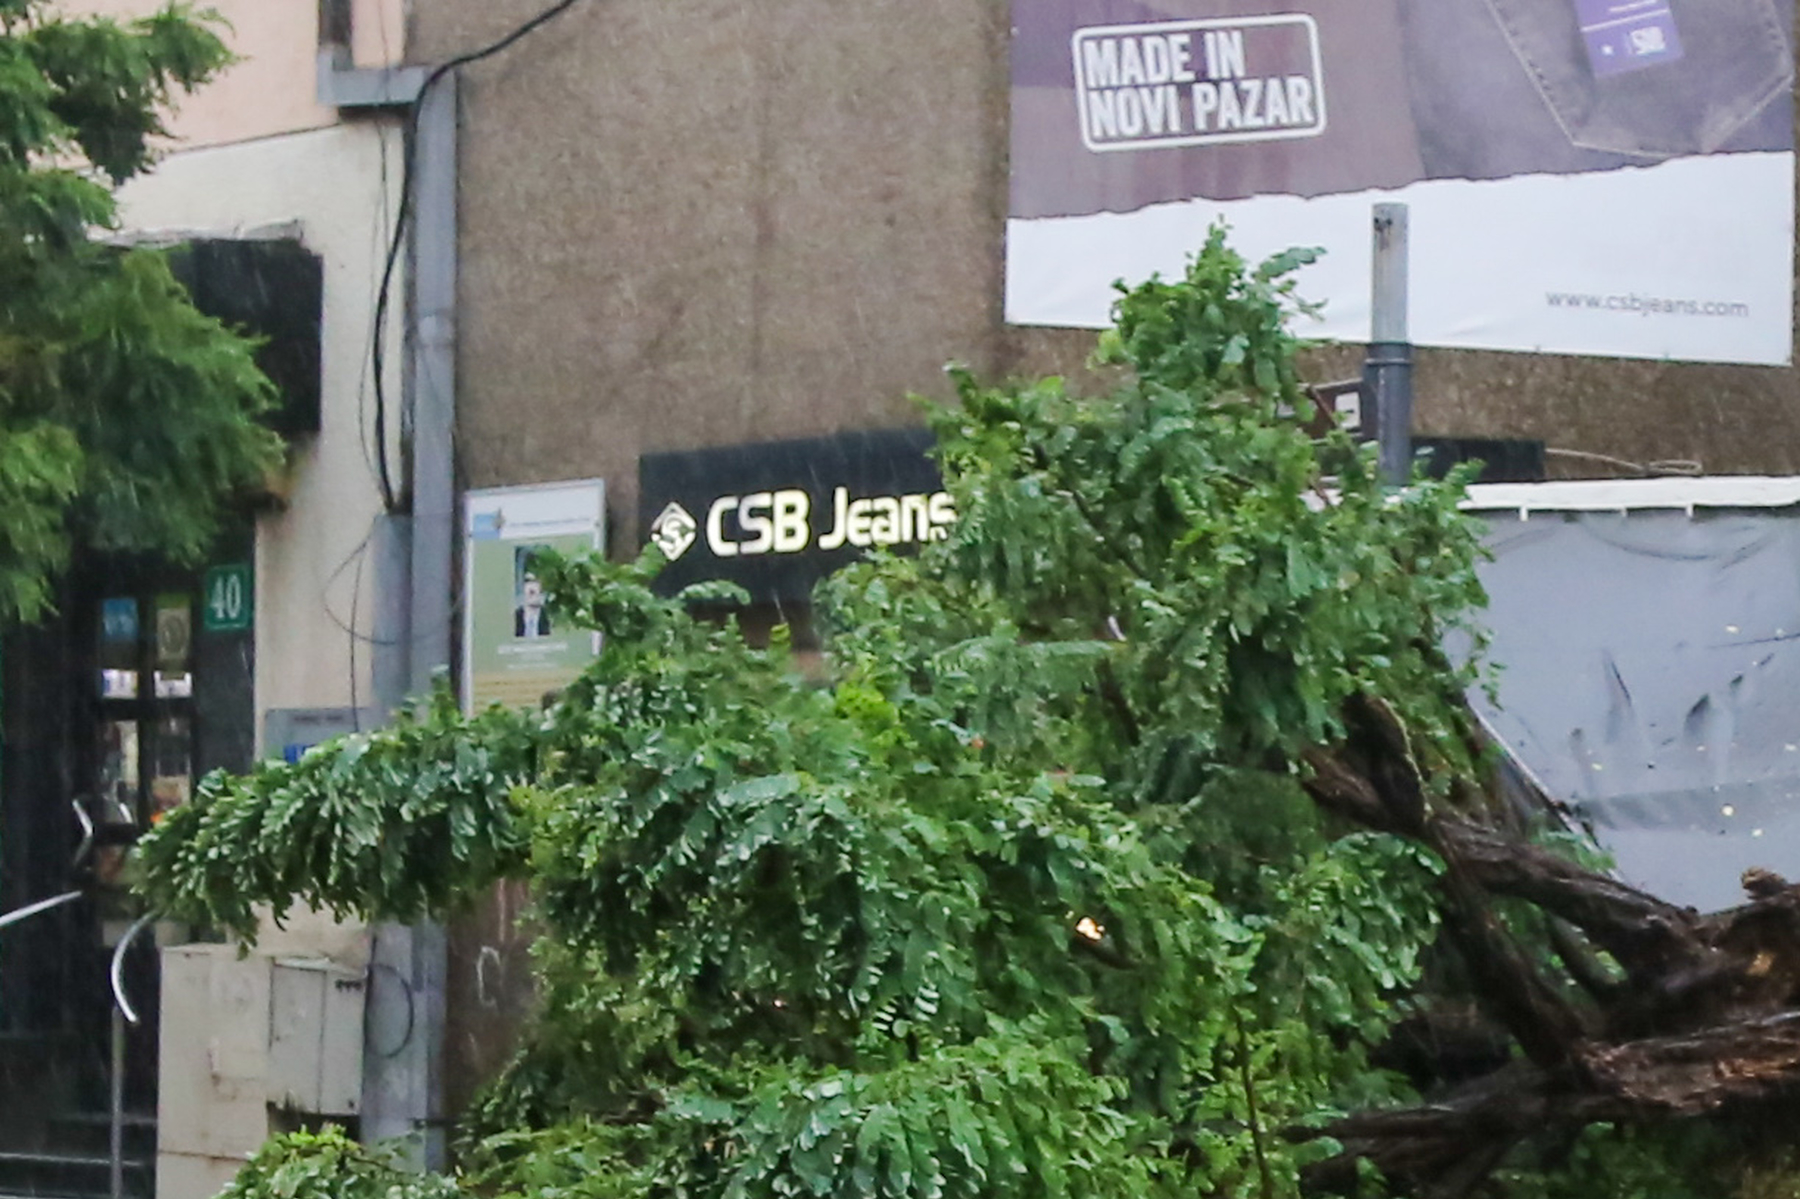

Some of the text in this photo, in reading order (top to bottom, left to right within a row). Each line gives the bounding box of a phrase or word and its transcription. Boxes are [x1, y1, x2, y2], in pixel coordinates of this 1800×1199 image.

[1083, 29, 1245, 88] MADE IN
[1088, 76, 1314, 138] NOVI PAZAR
[1546, 291, 1749, 317] www.csbjeans.com
[706, 486, 957, 557] CSB Jeans
[209, 574, 241, 619] 40
